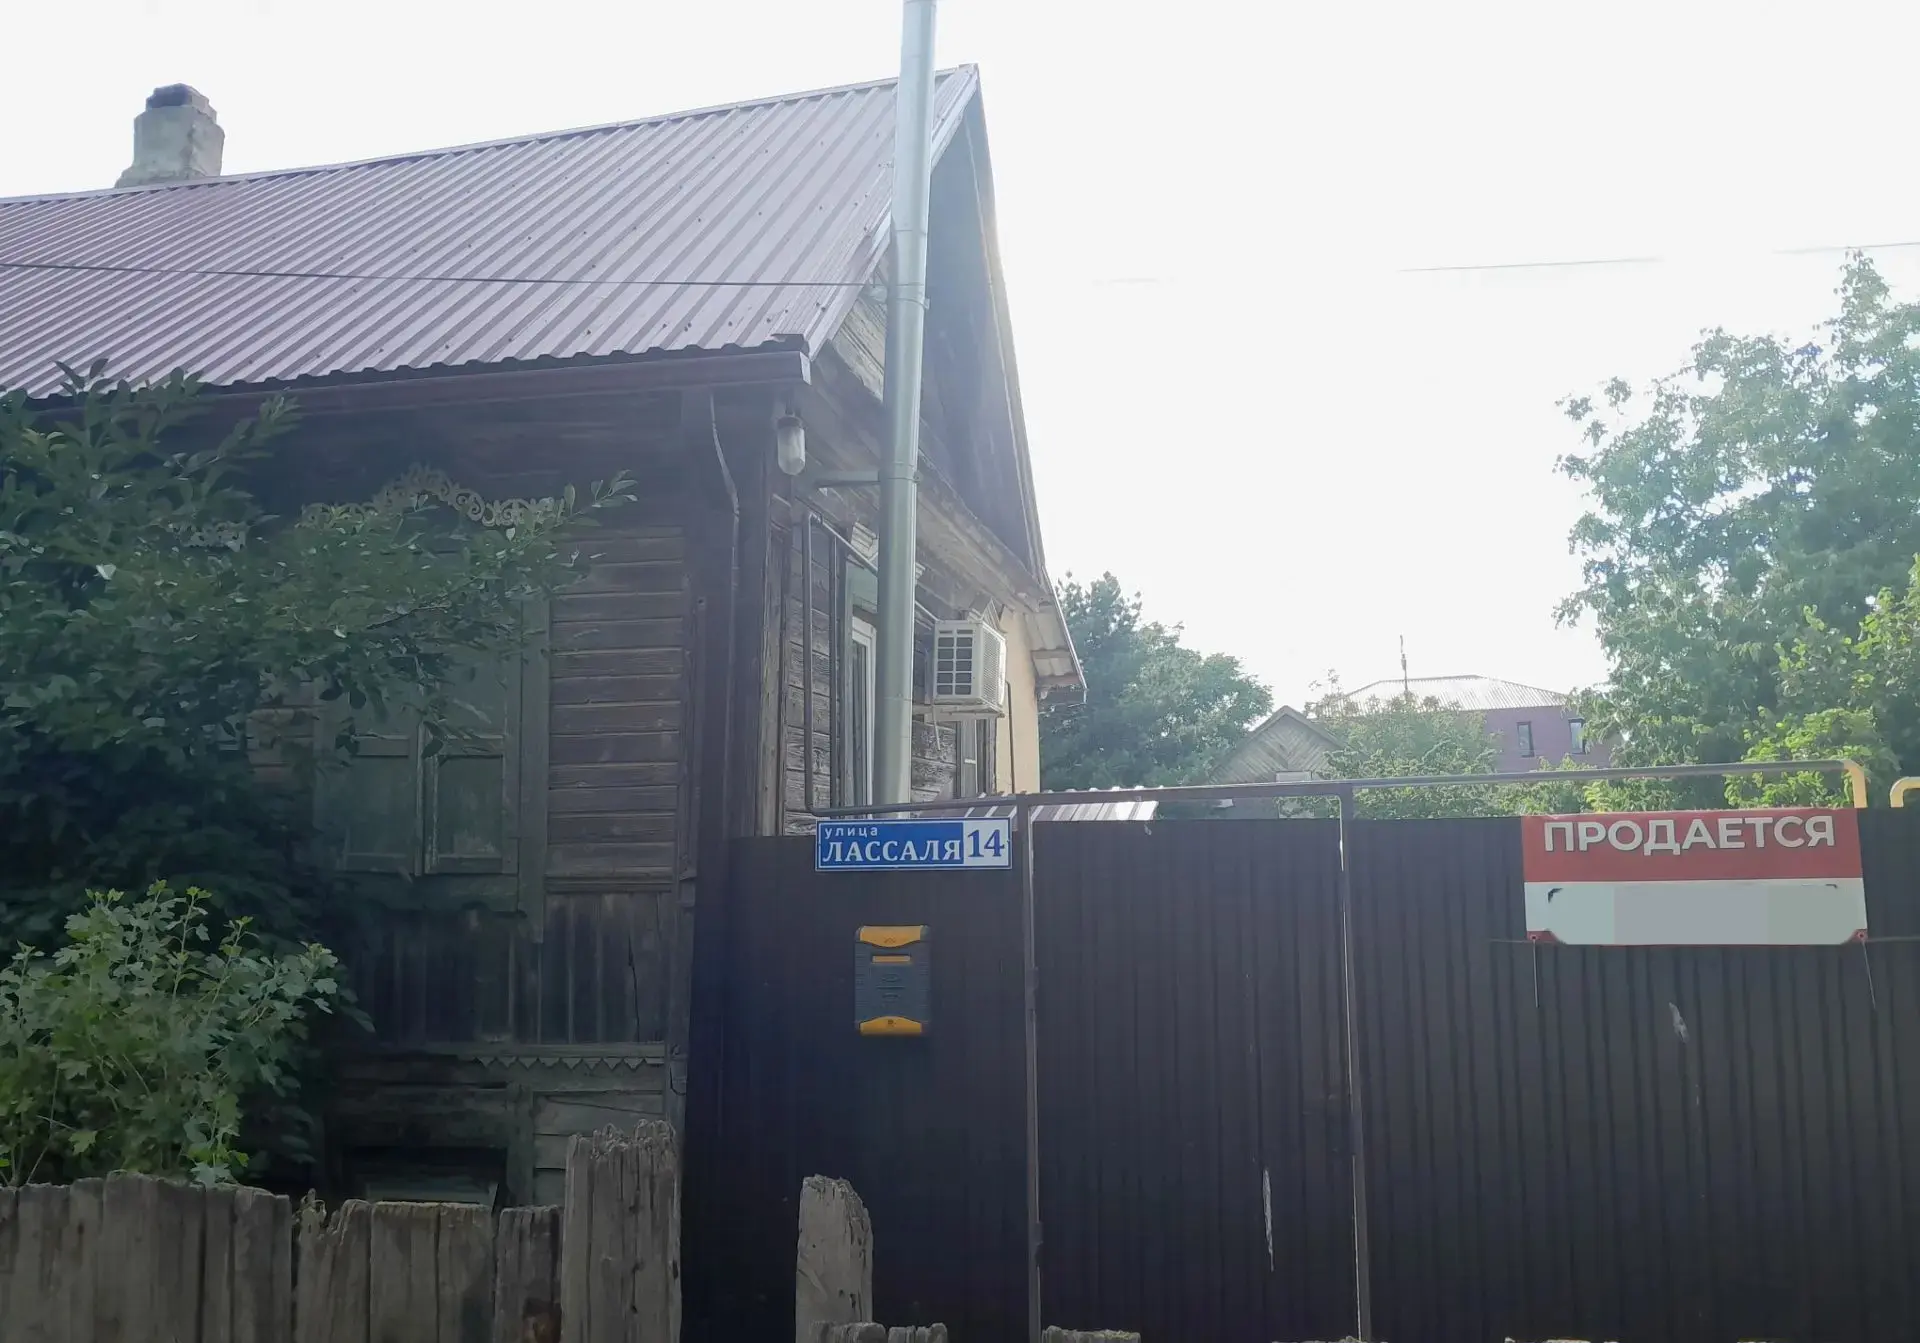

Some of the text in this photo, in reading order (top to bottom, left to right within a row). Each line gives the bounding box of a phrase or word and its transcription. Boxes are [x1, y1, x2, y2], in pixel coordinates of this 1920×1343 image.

[824, 826, 878, 839] улица
[967, 829, 1005, 858] 14
[1544, 815, 1835, 856] ПРОДАЕТСЯ
[822, 840, 961, 862] ЛАССАЛЯ
